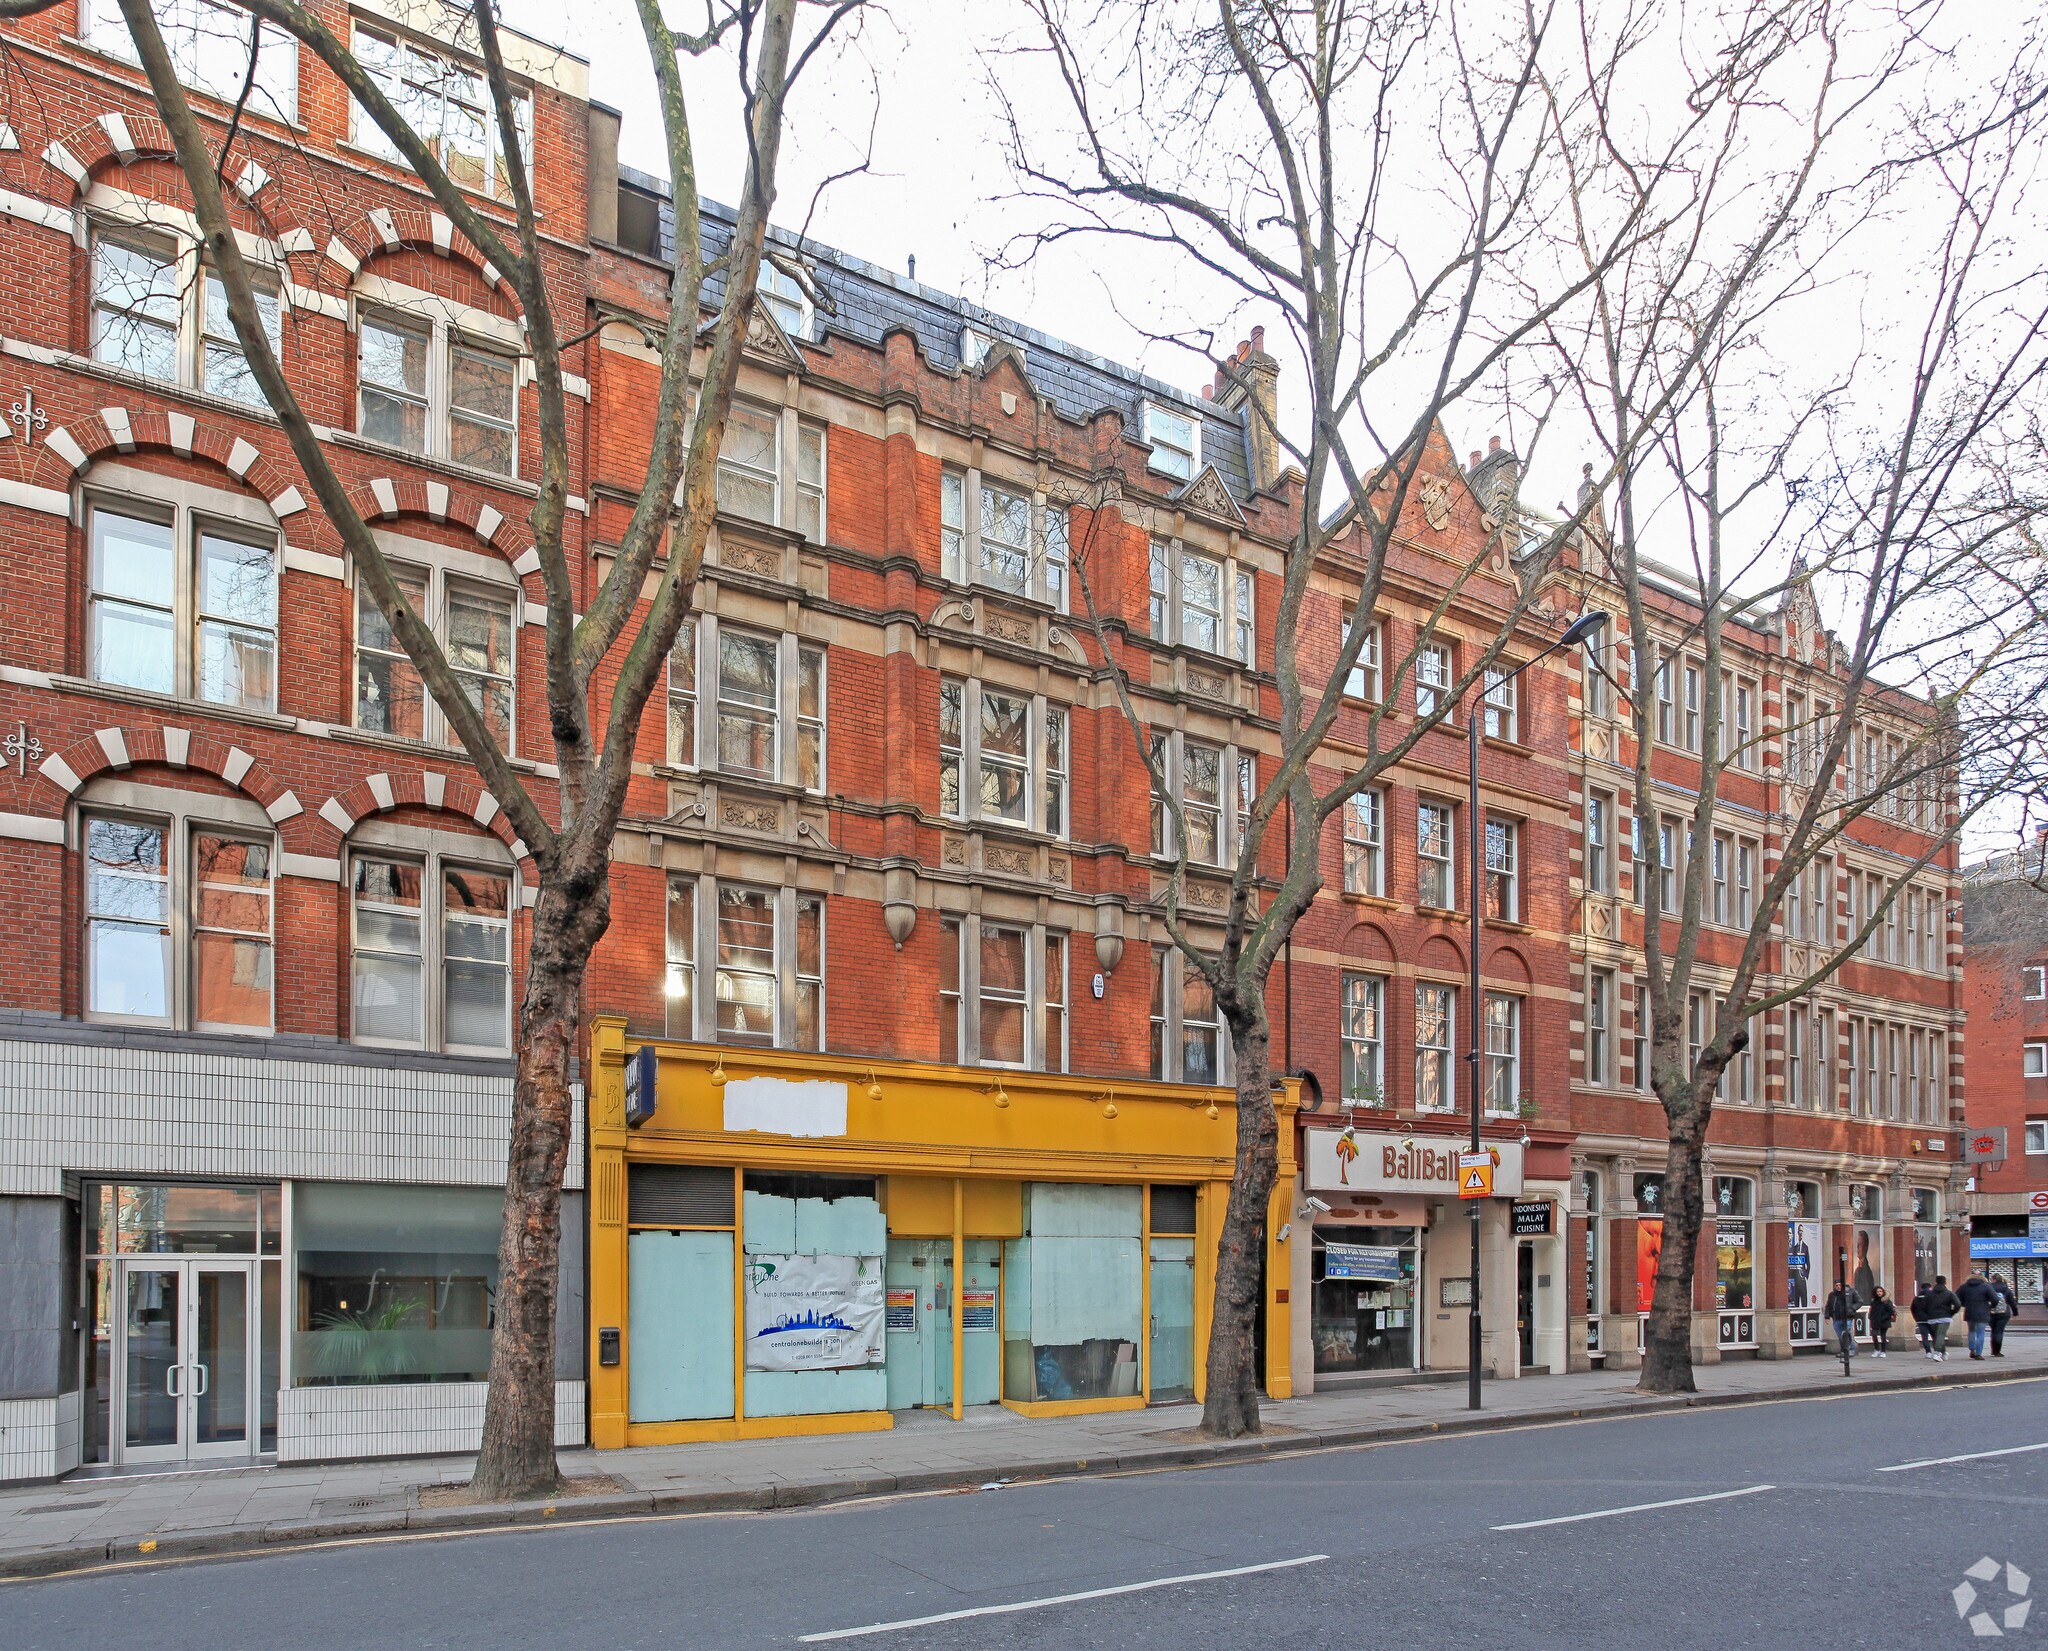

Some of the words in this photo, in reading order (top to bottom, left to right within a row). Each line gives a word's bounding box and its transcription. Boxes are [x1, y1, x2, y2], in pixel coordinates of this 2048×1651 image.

[1382, 1145, 1460, 1181] BaliBali
[1512, 1203, 1550, 1213] INDONESIAN
[1517, 1214, 1544, 1223] MALAY
[1516, 1224, 1545, 1233] CUISINE
[1326, 1246, 1347, 1254] CLOSED
[1971, 1243, 2003, 1251] SAINATH
[2004, 1242, 2026, 1250] NEWS
